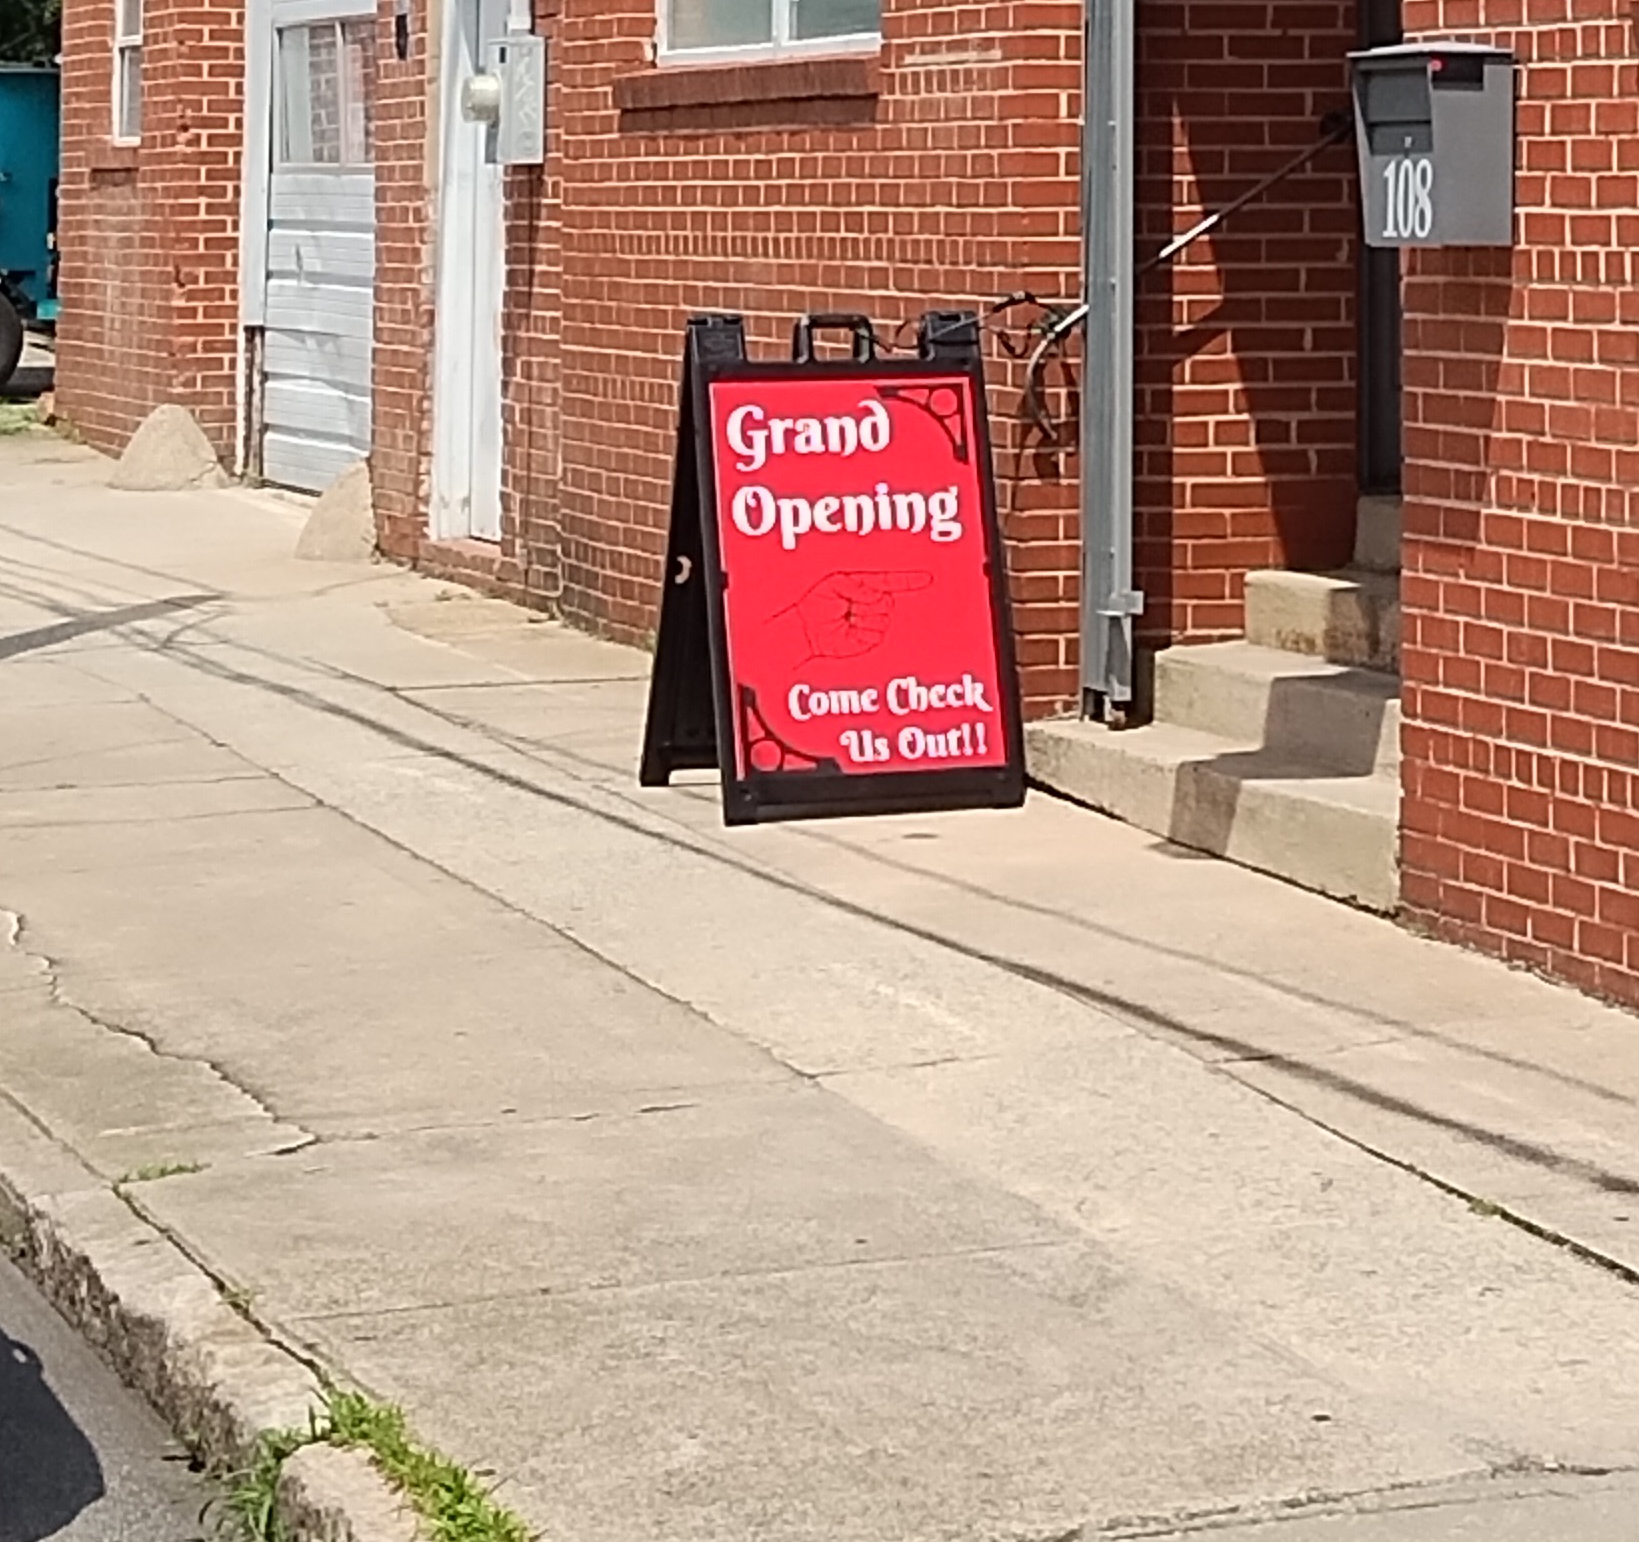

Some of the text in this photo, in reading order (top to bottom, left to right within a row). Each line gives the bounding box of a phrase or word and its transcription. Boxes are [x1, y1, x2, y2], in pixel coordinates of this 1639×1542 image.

[1382, 158, 1433, 238] 108
[726, 399, 890, 472] Grand
[732, 482, 963, 550] Opening
[788, 674, 994, 721] Come Check
[839, 722, 987, 762] Us Out!!
